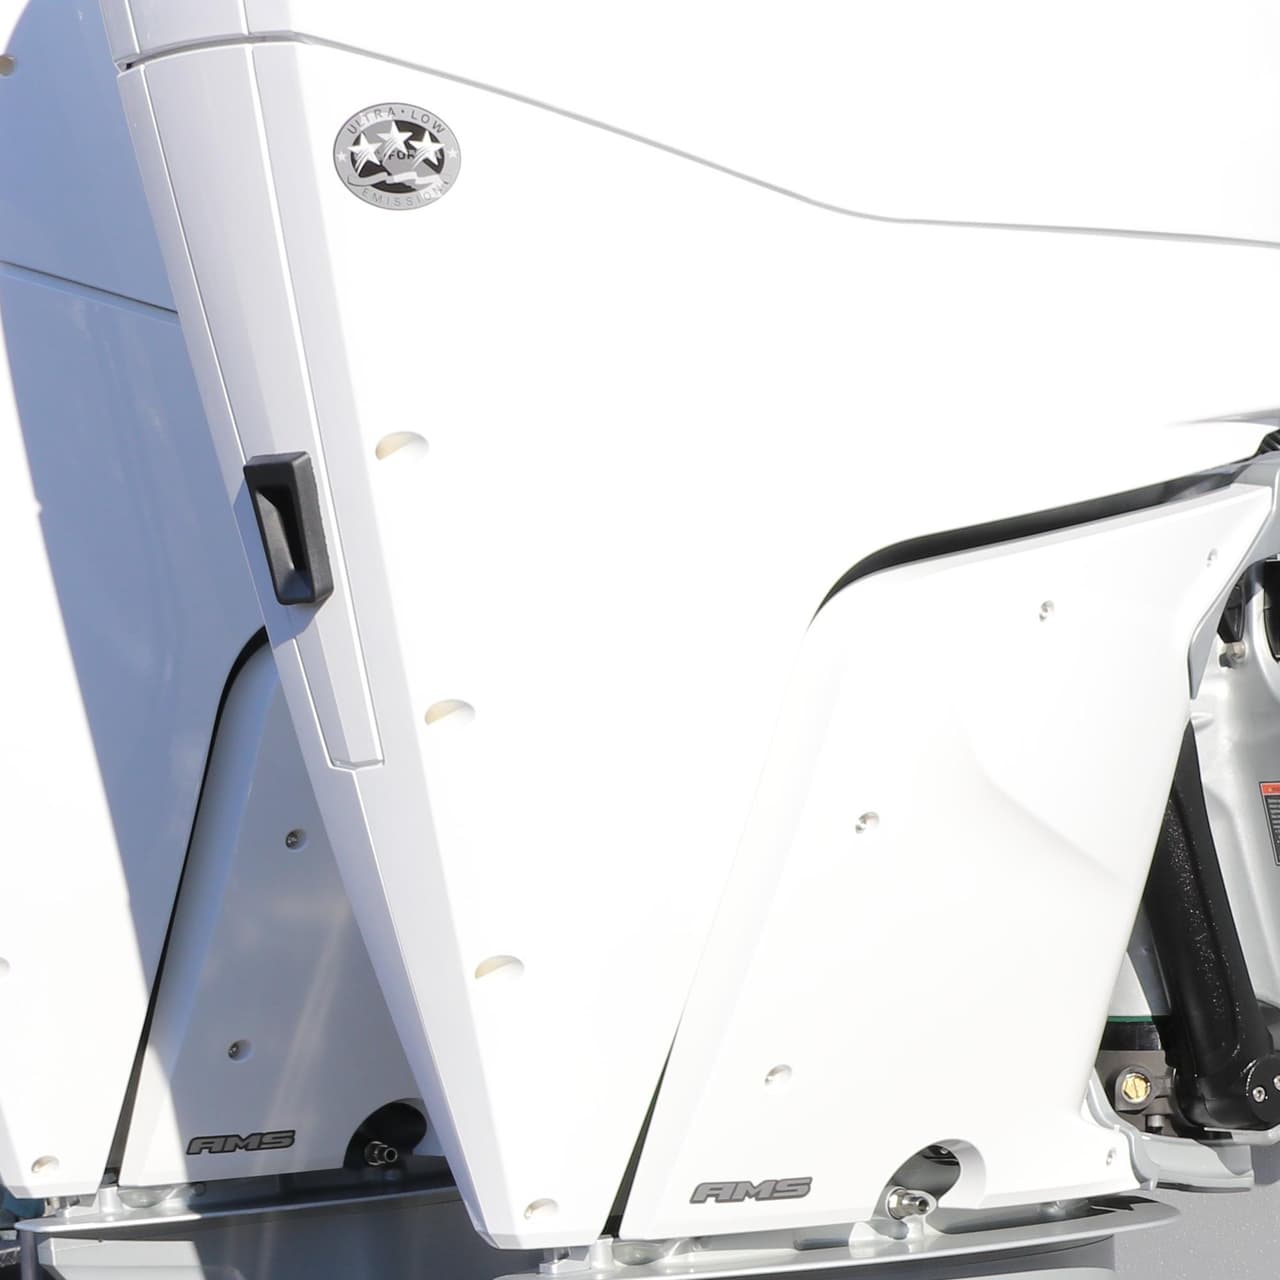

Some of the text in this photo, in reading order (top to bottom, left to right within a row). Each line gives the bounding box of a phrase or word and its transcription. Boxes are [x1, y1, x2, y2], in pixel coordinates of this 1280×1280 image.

[347, 106, 447, 136] ULTRA LOW
[186, 1129, 296, 1156] AMS
[689, 1176, 813, 1205] AMS
